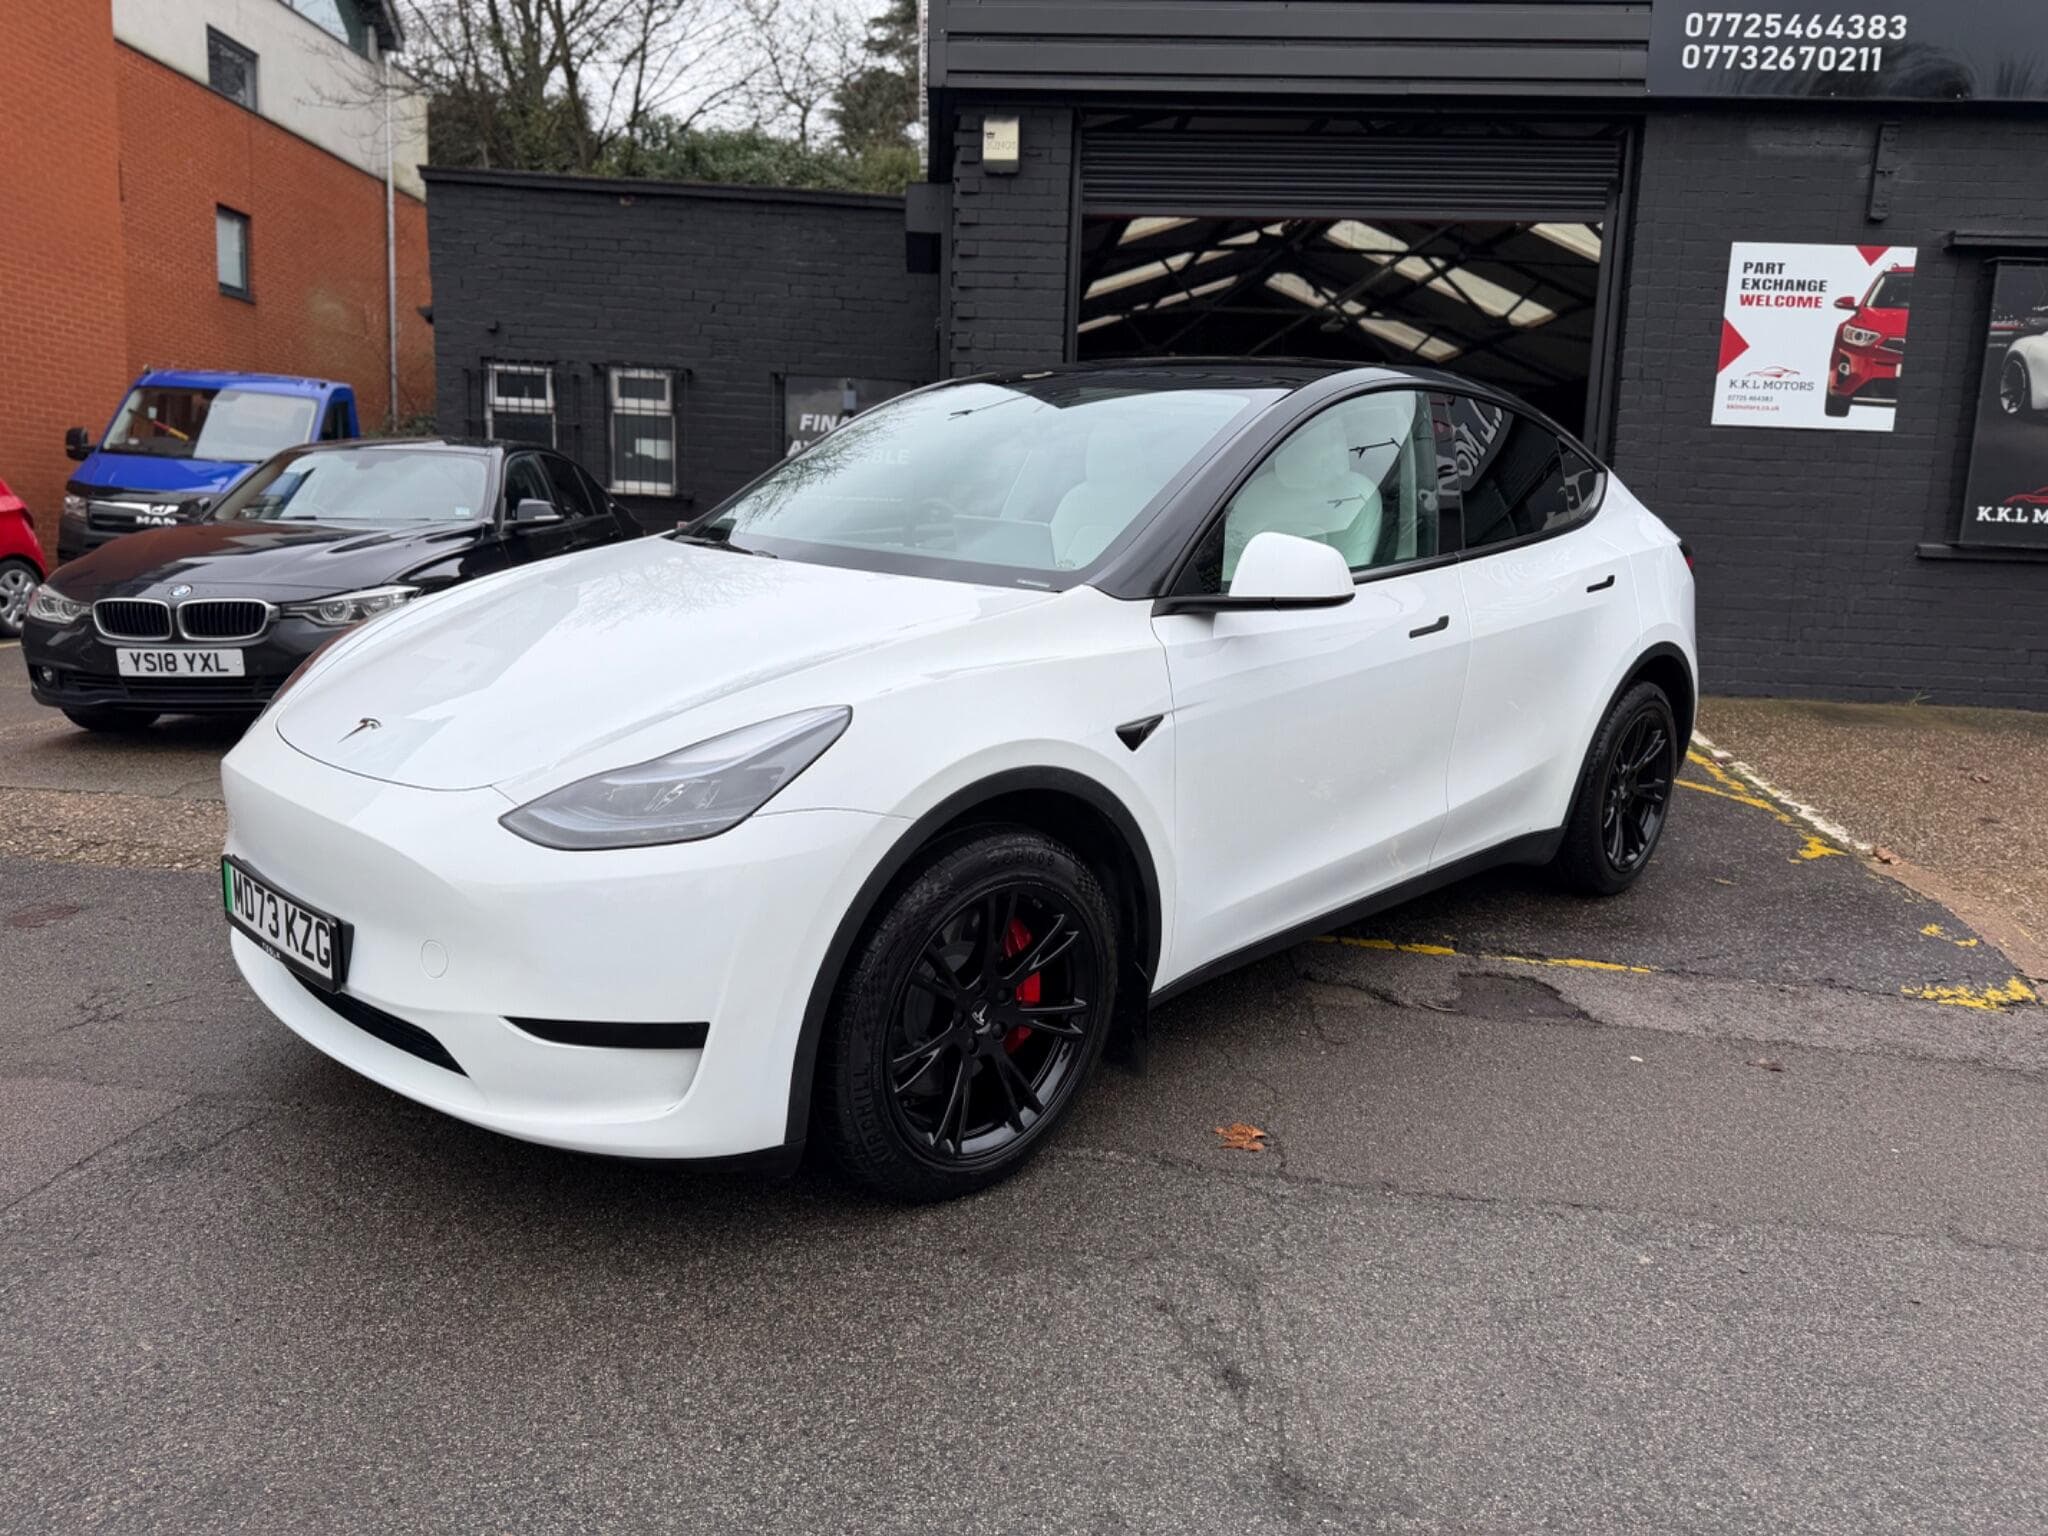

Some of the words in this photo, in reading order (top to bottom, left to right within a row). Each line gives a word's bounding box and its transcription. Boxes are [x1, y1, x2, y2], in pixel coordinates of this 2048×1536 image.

[1685, 12, 1908, 40] 07725464383
[1682, 44, 1883, 72] 07732670211
[1743, 261, 1786, 275] PART
[1741, 278, 1828, 293] EXCHANGE
[1740, 294, 1824, 309] WELCOME
[1729, 379, 1761, 390] K.K.L
[1762, 381, 1815, 391] MOTORS
[136, 515, 178, 526] MAN
[1976, 506, 2029, 523] K.K.L
[130, 652, 178, 673] YS18
[183, 652, 230, 673] YXL
[232, 869, 280, 940] MD73
[284, 902, 332, 970] KZG
